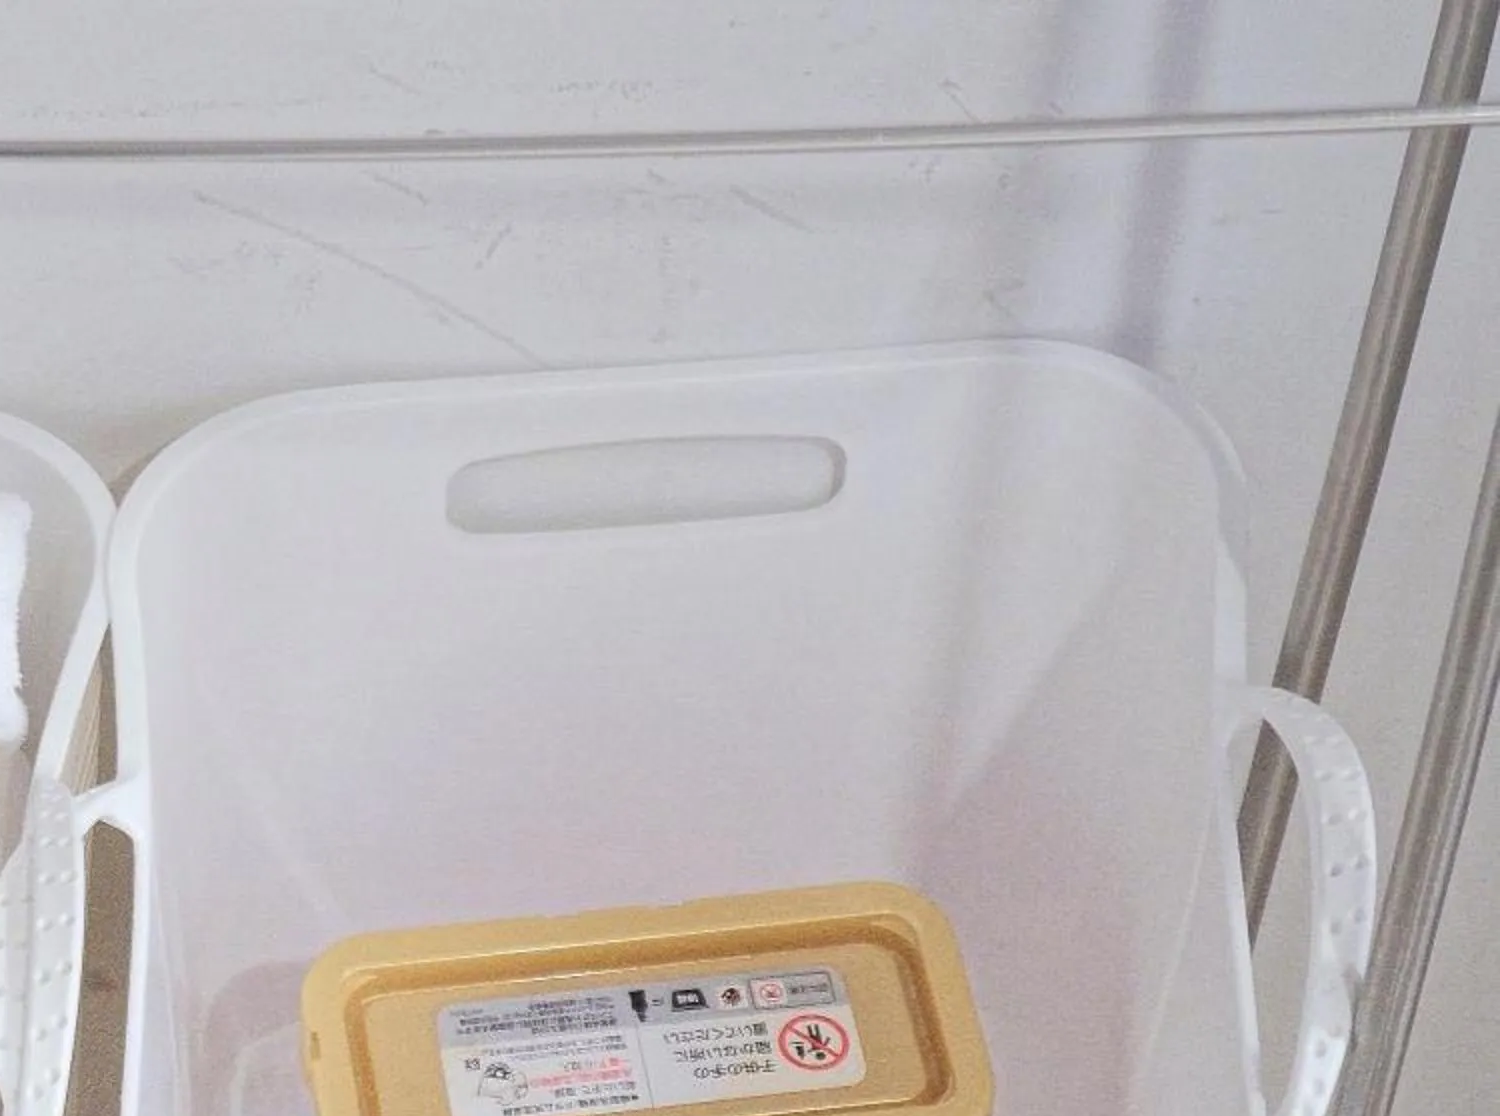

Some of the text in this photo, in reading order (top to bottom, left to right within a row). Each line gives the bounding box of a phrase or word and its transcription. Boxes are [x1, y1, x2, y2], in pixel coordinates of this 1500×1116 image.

[662, 1022, 768, 1045] 置いてください
[672, 1041, 773, 1064] 届かない所に
[693, 1059, 777, 1080] 子供の手の
